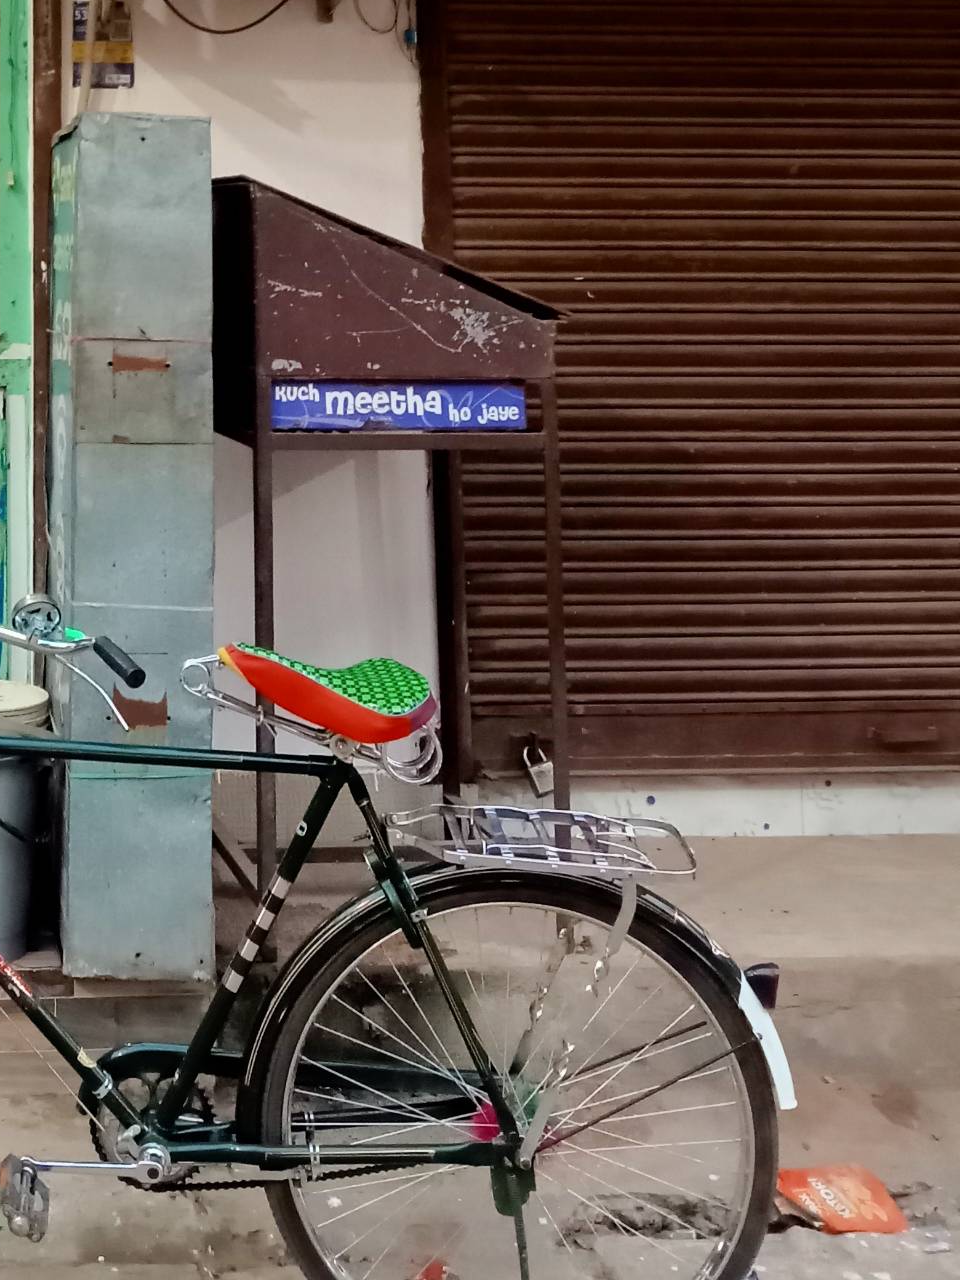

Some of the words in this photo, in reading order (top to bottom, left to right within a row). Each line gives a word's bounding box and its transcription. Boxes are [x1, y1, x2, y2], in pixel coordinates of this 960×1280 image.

[326, 386, 442, 416] meetha
[448, 403, 472, 422] ho
[477, 403, 520, 424] jaye
